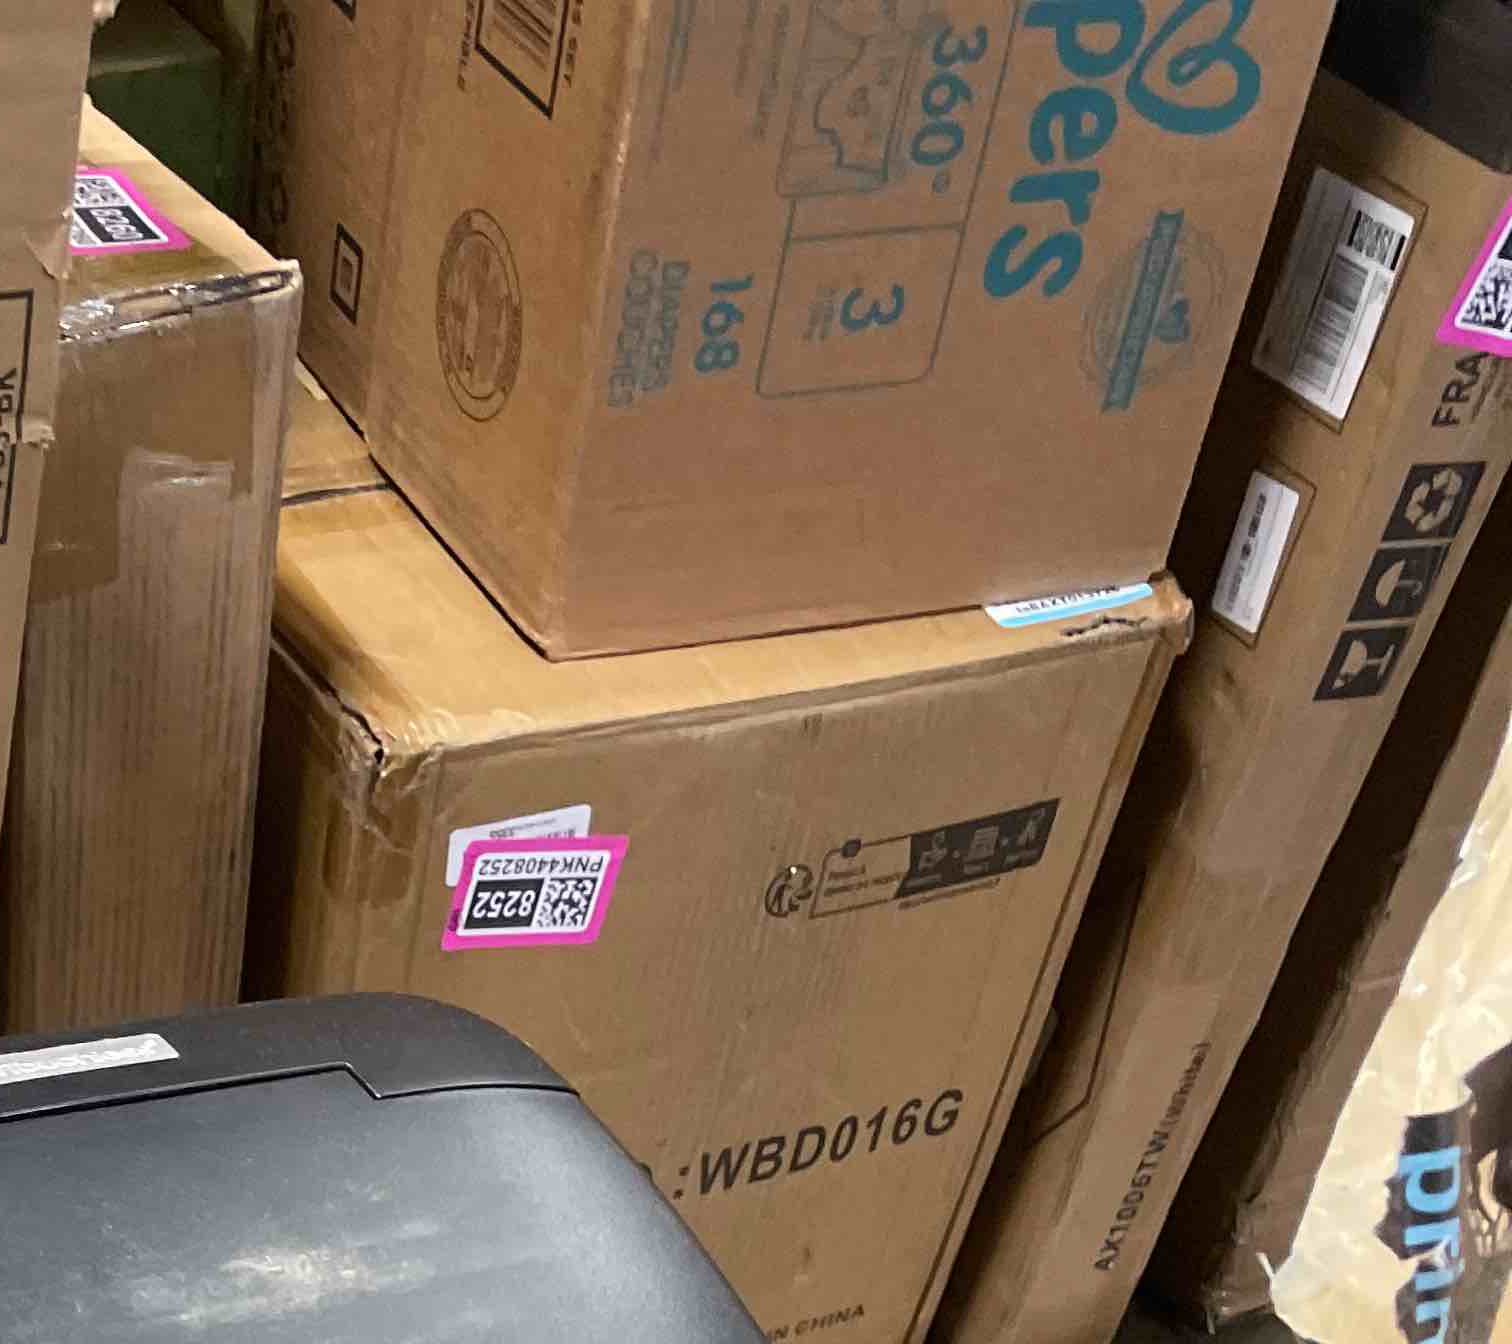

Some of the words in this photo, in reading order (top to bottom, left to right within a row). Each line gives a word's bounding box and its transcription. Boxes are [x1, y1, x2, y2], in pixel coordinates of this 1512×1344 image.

[840, 280, 905, 332] 3
[693, 273, 754, 374] 168
[478, 855, 604, 876] PNK4408252
[471, 889, 537, 919] 8252
[794, 1303, 864, 1337] CHINA
